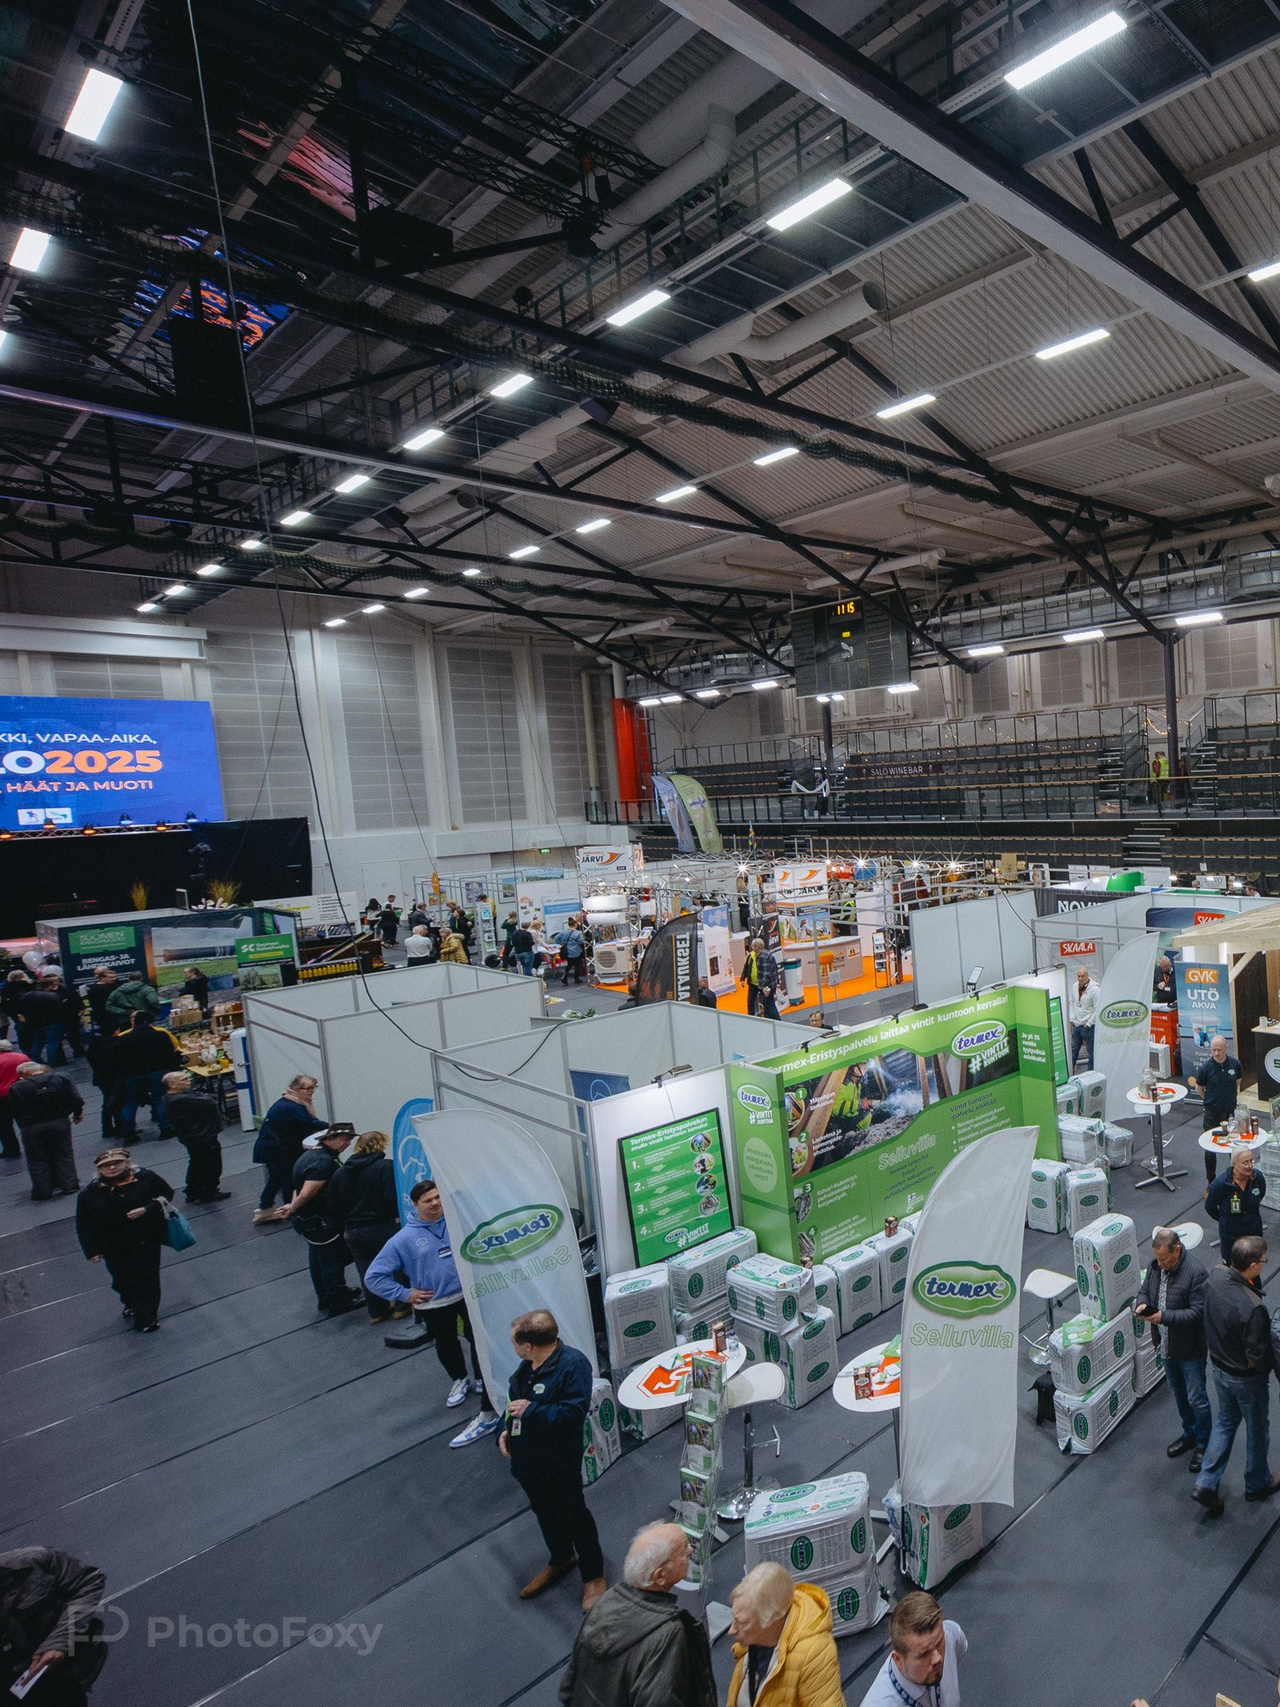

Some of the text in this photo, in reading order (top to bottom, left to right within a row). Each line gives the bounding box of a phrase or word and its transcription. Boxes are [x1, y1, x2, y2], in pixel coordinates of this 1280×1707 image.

[36, 733, 157, 744] VAPAA-AIKA,
[0, 750, 163, 774] O2025
[6, 780, 153, 793] HÄÄT JA MUOTI
[581, 853, 604, 864] JÄRVI
[1062, 942, 1093, 954] SKAALA
[1187, 987, 1220, 1001] UTÖ
[1191, 1001, 1217, 1010] AKVA
[880, 1024, 910, 1041] laittaa
[911, 1016, 934, 1031] vintit
[937, 1006, 975, 1022] kuntoon
[976, 994, 1009, 1012] kerralla!
[1106, 1009, 1141, 1019] termex
[957, 1028, 1002, 1051] termex
[968, 1038, 1009, 1074] #VINTIT
[983, 1047, 1009, 1068] KUNTOON
[740, 1089, 769, 1106] termex
[630, 1116, 708, 1146] Termex-Eristyspalvelun
[800, 1133, 807, 1142] 2
[878, 1134, 936, 1171] Selluvilla
[631, 1160, 640, 1170] 1.
[634, 1182, 645, 1193] 2.
[805, 1183, 811, 1192] 3
[637, 1204, 648, 1214] 3.
[640, 1226, 651, 1236] 4.
[808, 1228, 815, 1236] 4
[925, 1276, 1003, 1298] termex
[910, 1322, 1014, 1349] Selluvilla
